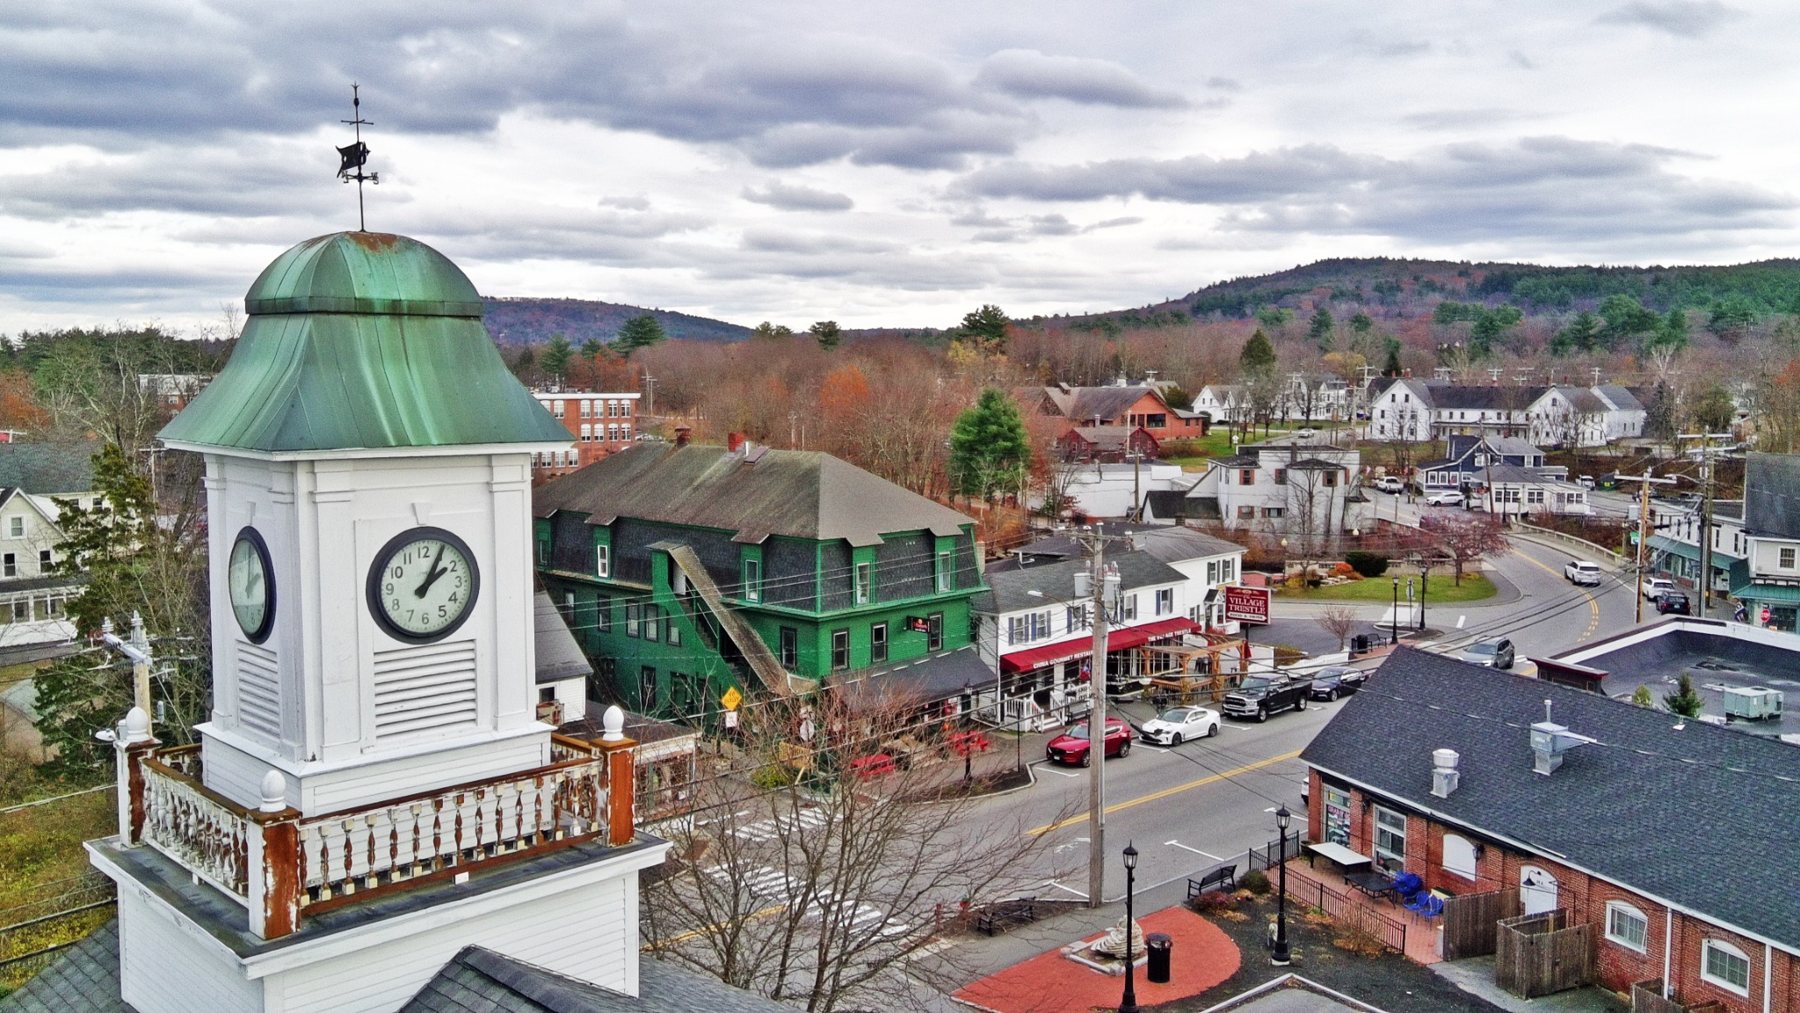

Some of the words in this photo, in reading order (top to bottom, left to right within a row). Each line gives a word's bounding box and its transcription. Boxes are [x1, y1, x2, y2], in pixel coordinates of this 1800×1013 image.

[403, 552, 411, 565] 11
[417, 546, 430, 558] 12
[390, 566, 403, 579] 10
[449, 560, 457, 572] 2
[454, 576, 462, 588] 3
[385, 583, 394, 595] 9
[448, 591, 458, 604] 4
[1229, 597, 1264, 607] VILLAGE
[391, 598, 400, 611] 8
[1228, 604, 1265, 614] TRESTLE
[406, 609, 415, 622] 7
[438, 605, 447, 618] 5
[421, 612, 429, 625] 6
[1033, 660, 1049, 668] CHINA
[1049, 654, 1074, 665] GOURMET
[1074, 650, 1094, 659] RESTAU
